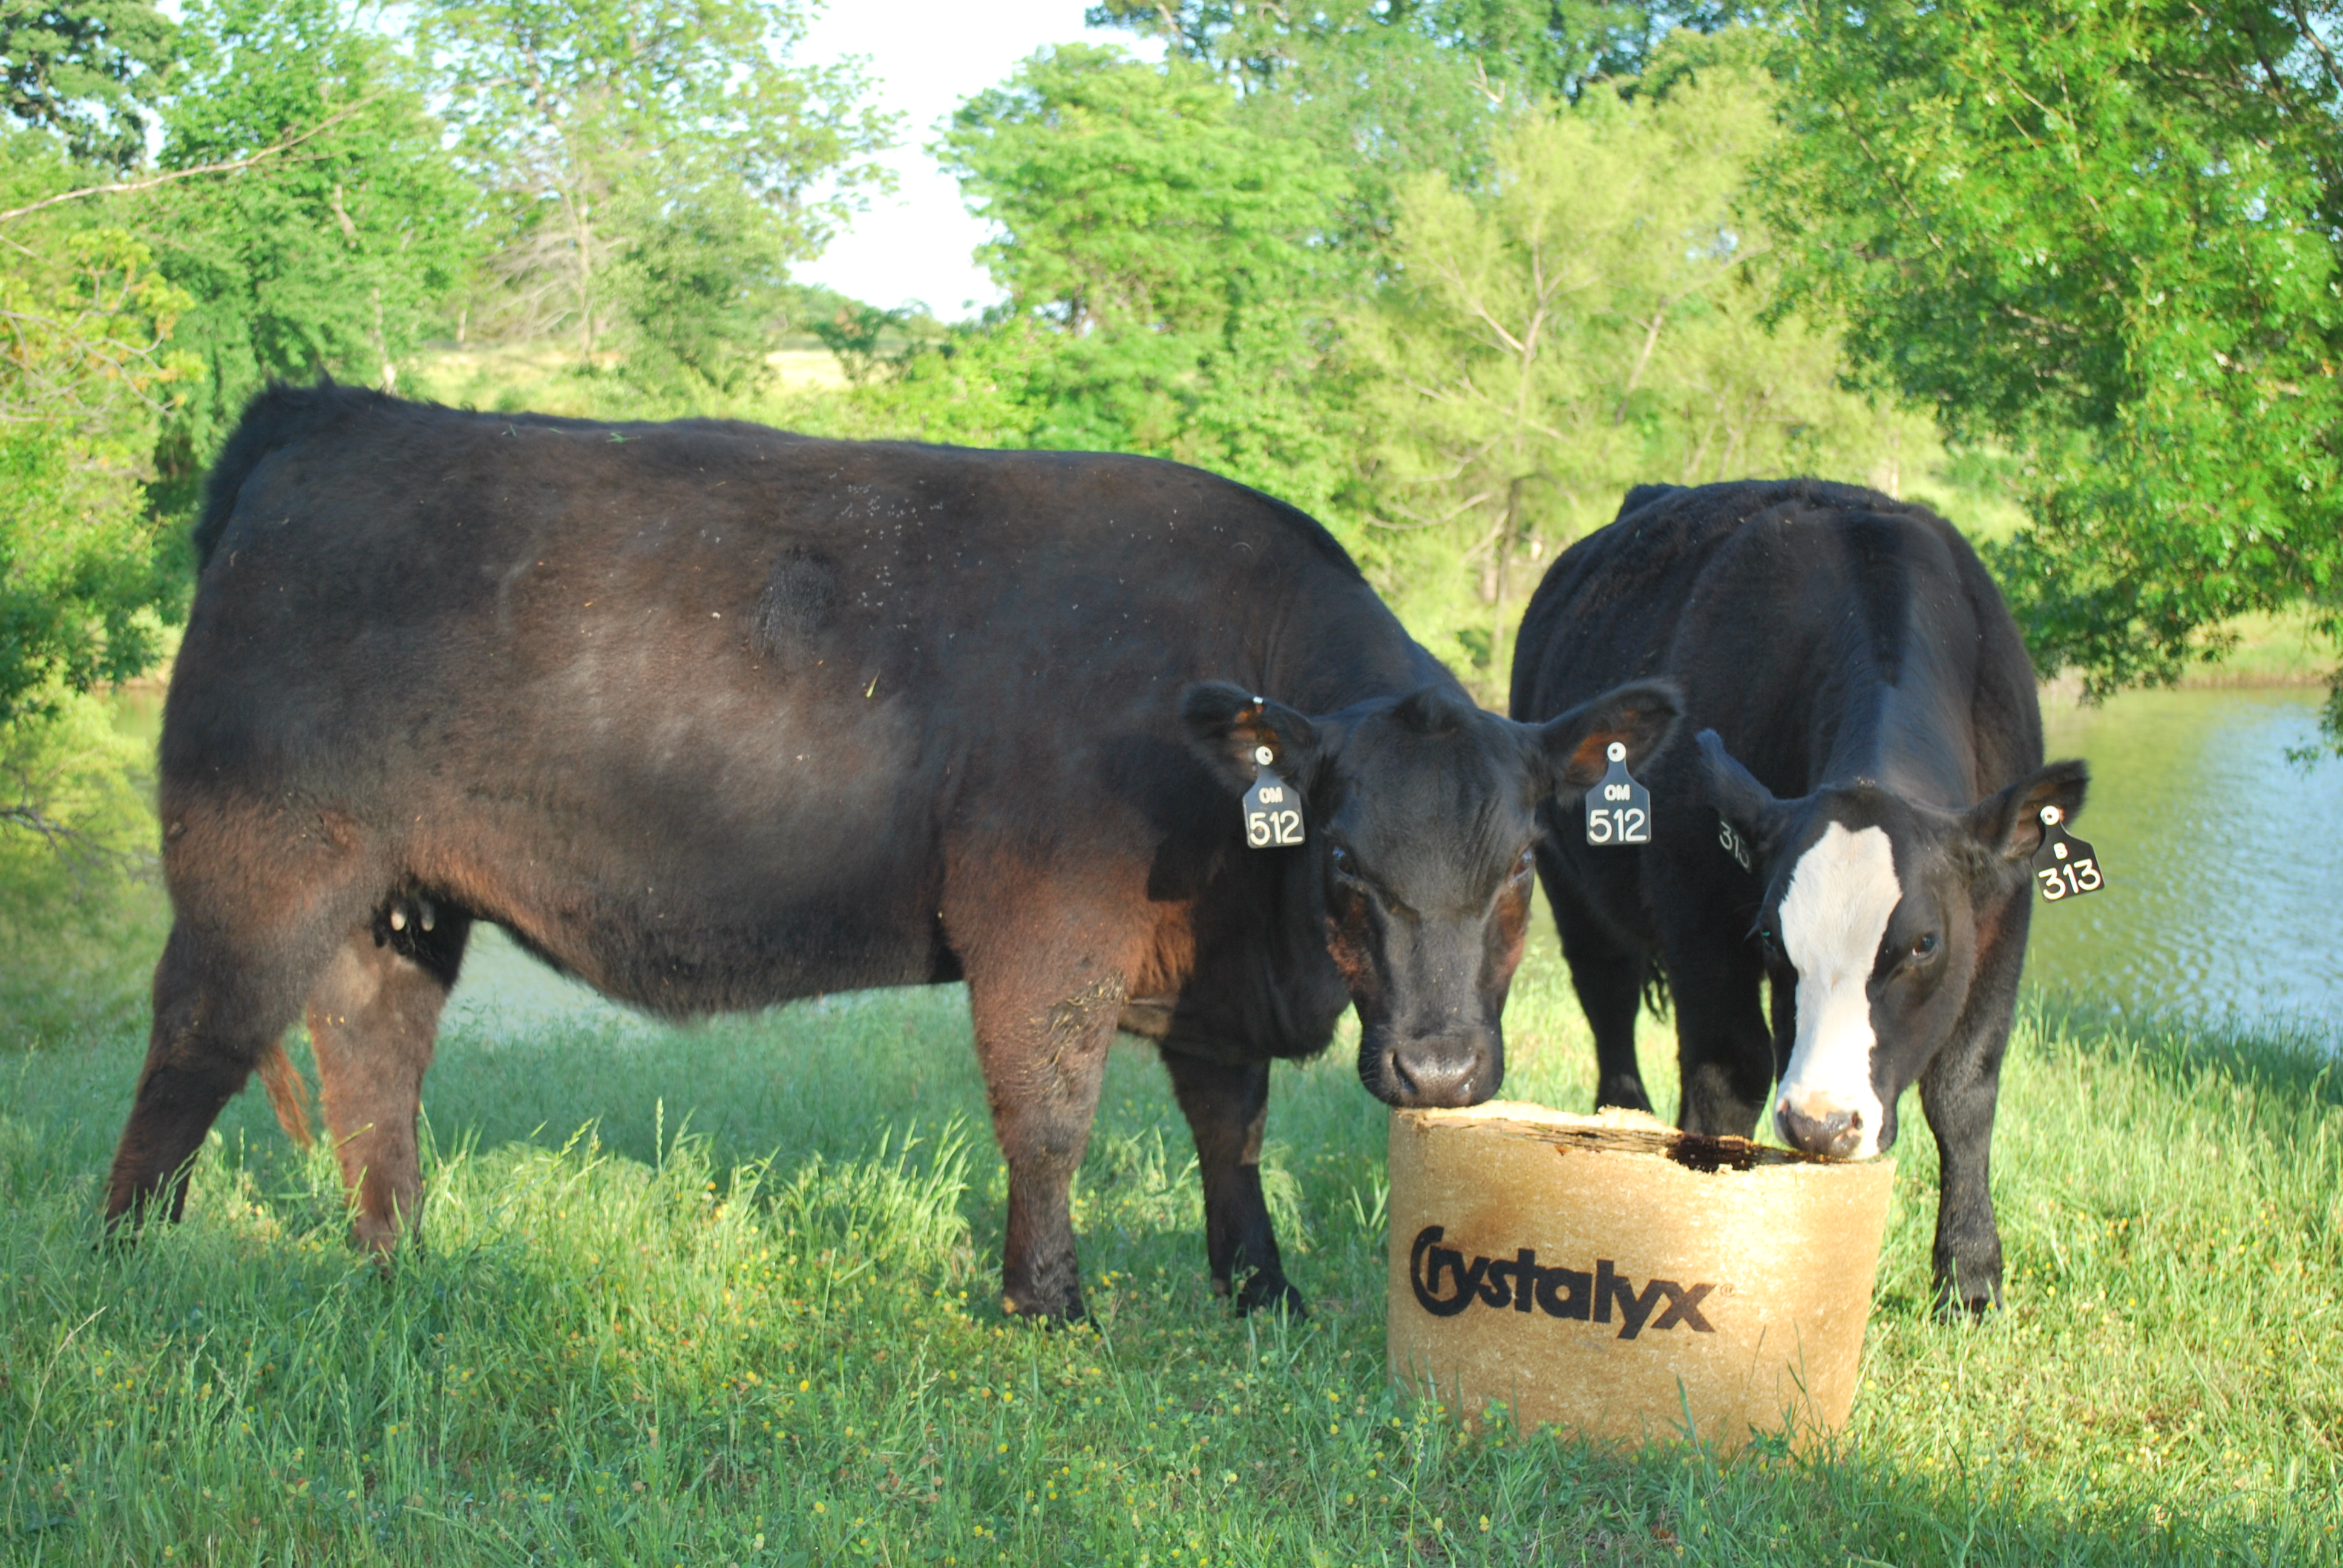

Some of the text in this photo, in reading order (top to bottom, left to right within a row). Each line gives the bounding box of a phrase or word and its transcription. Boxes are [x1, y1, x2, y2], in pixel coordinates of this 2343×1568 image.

[1250, 810, 1303, 845] 512
[1589, 808, 1647, 842] 512
[2053, 842, 2068, 860] B
[2038, 858, 2101, 900] 313
[1411, 1225, 1717, 1339] Crystalyx
